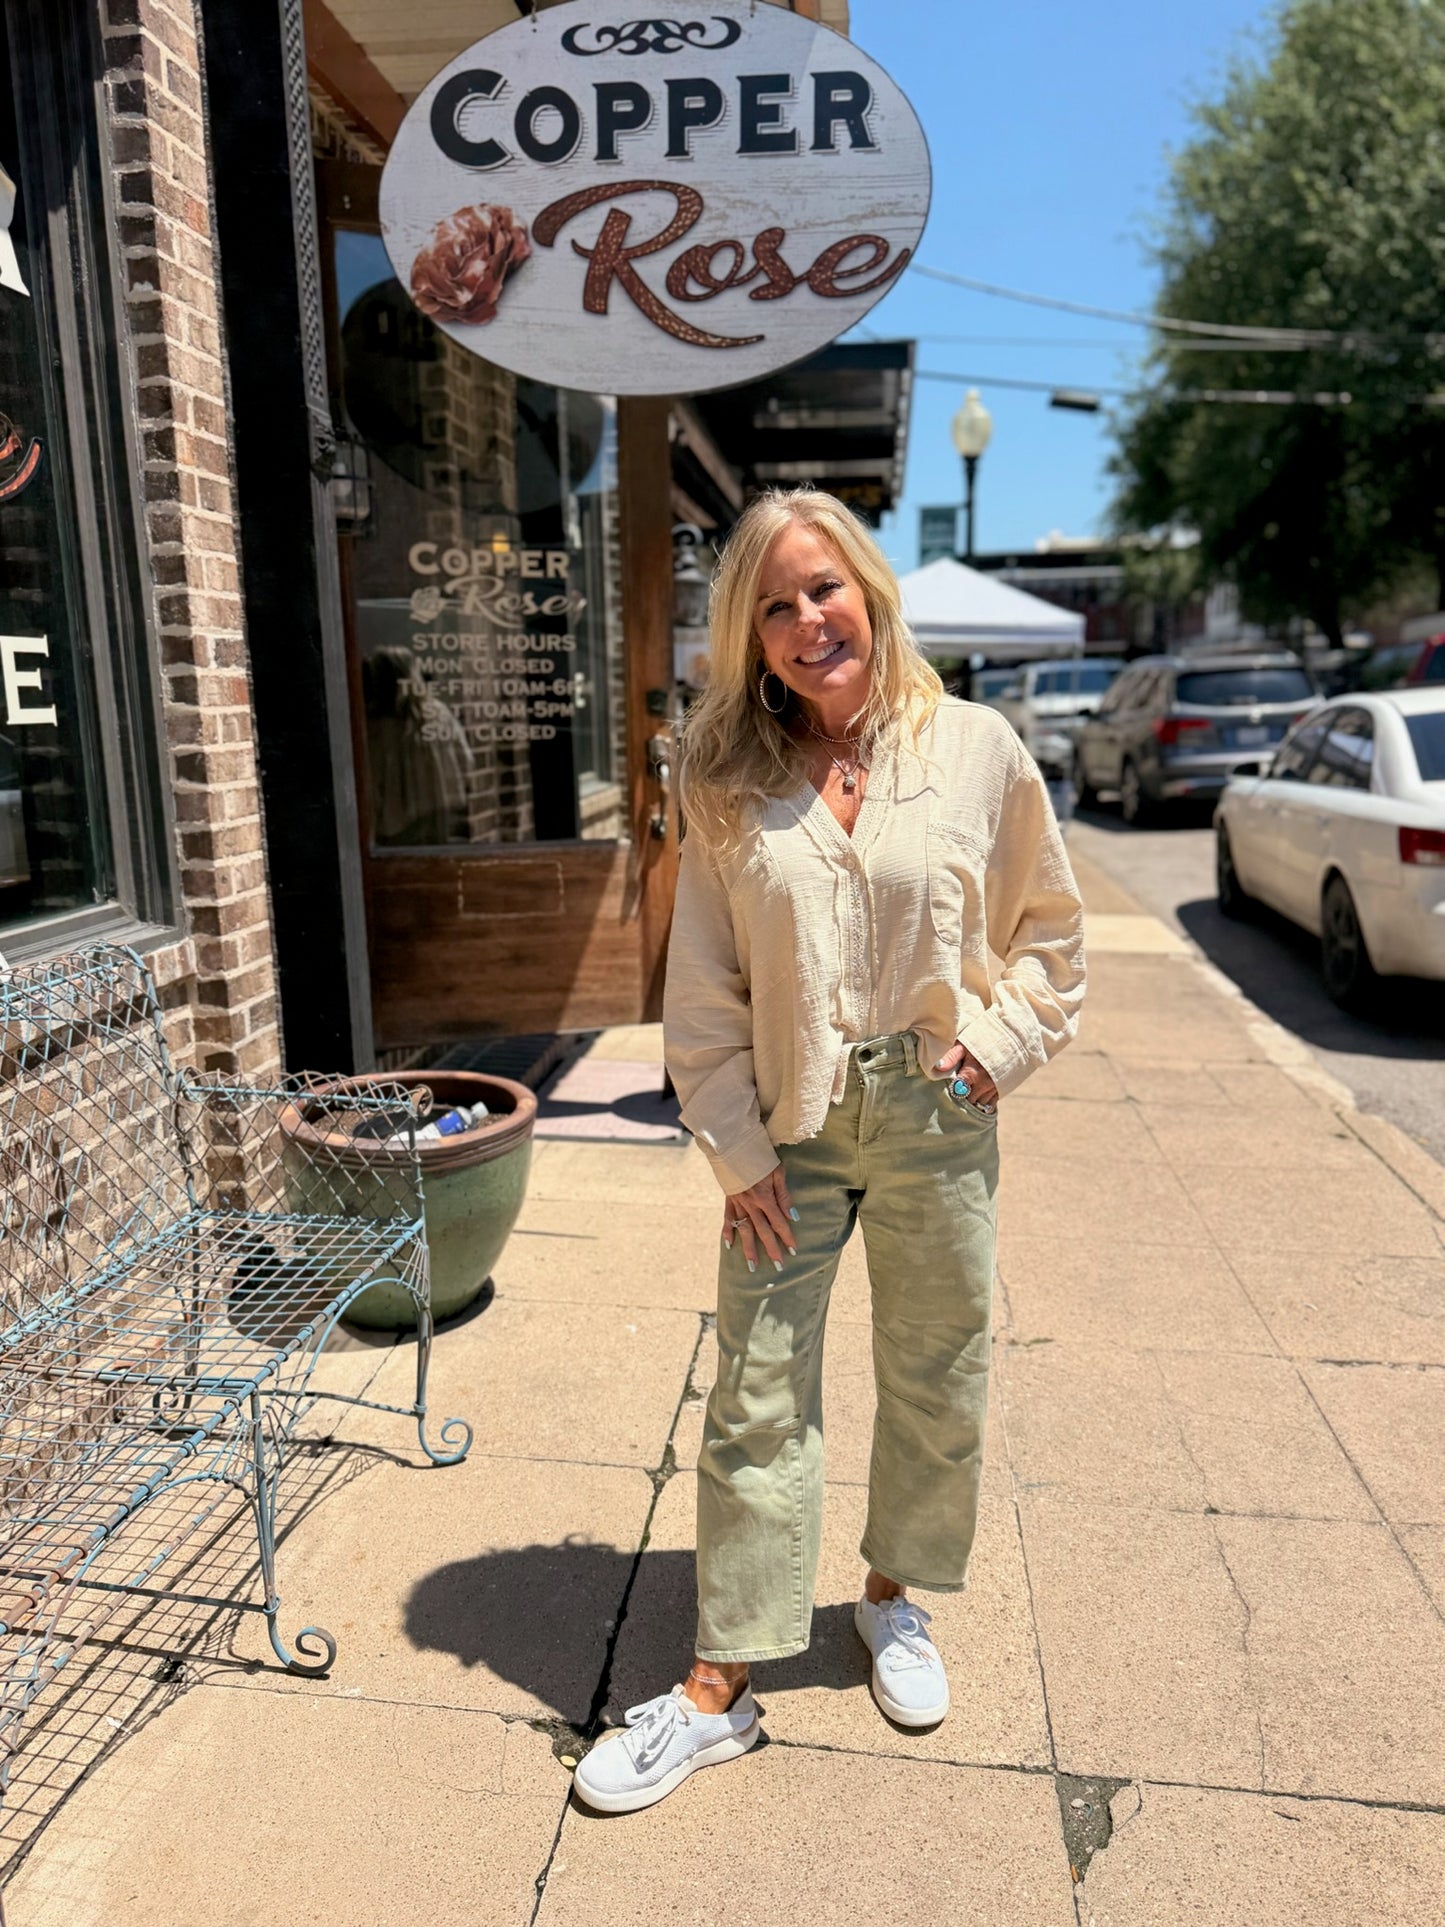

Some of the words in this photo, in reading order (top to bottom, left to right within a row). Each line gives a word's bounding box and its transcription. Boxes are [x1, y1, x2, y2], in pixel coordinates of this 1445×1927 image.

[430, 68, 877, 171] COPPER
[531, 179, 911, 349] Rose
[408, 541, 570, 579] COPPER
[443, 575, 584, 629] Rose
[412, 633, 489, 651] STORE
[496, 633, 577, 651] HOURS
[414, 656, 463, 674] MON
[472, 657, 555, 674] CLOSED
[473, 700, 576, 719] 10AM-5PM
[474, 723, 556, 741] CLOSED
